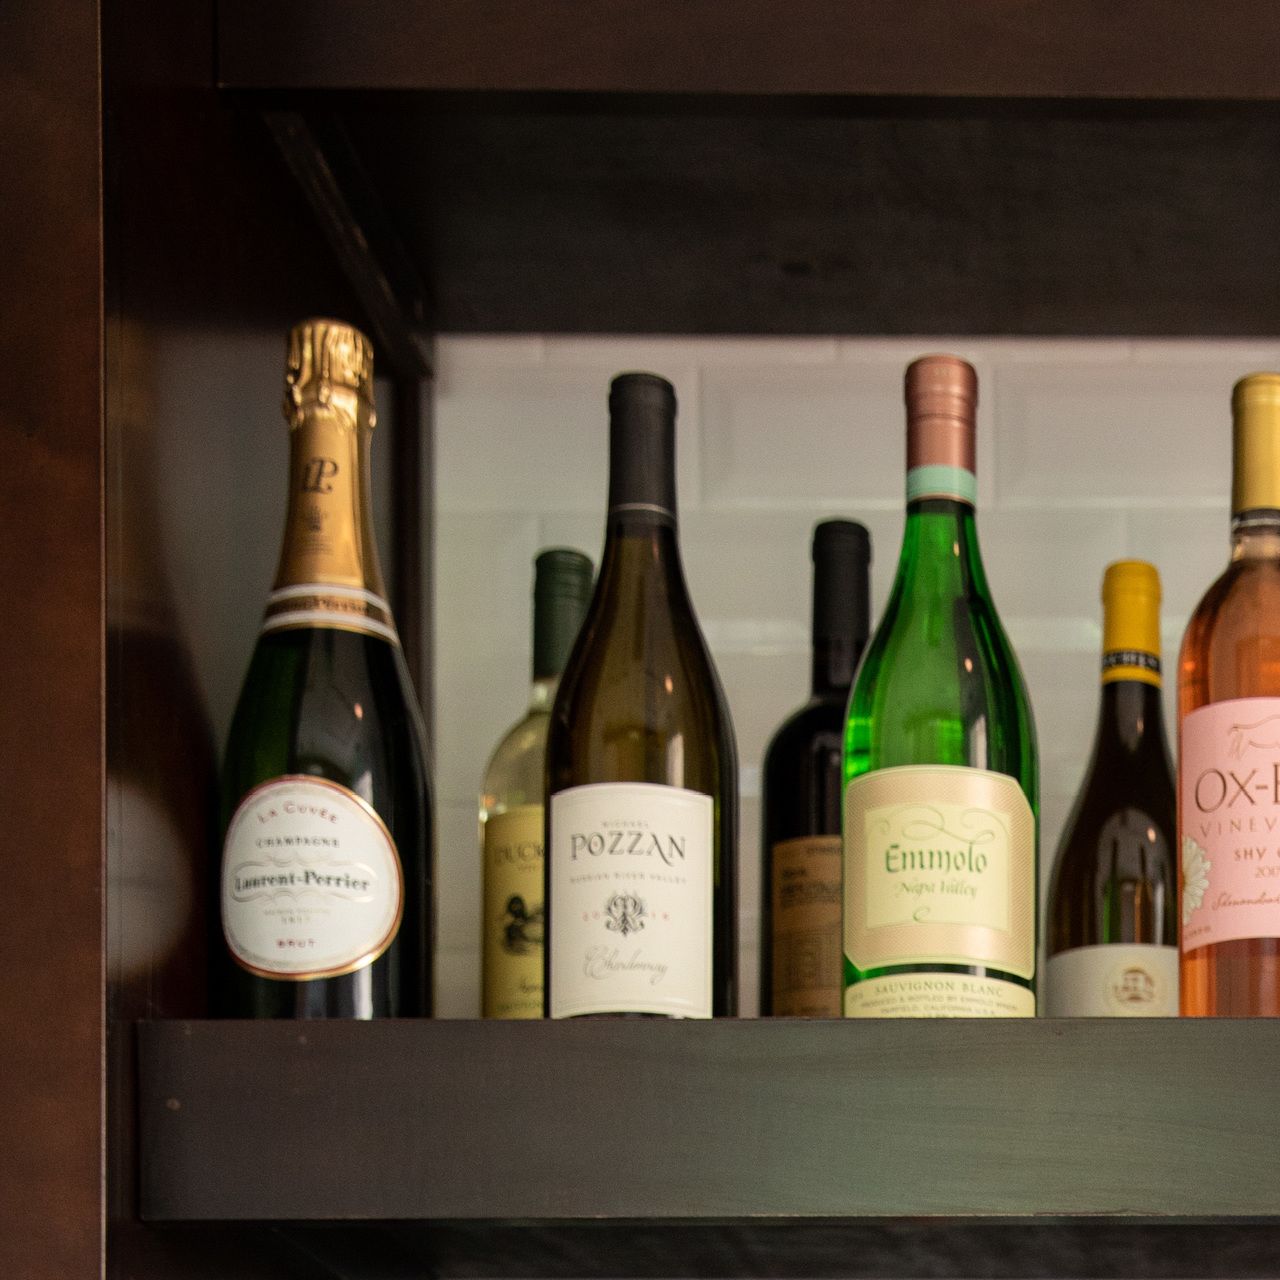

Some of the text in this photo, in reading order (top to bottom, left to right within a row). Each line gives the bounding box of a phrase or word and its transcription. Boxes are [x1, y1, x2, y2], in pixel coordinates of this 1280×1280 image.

[255, 837, 341, 849] CHAMPAGNE
[570, 830, 687, 868] POZZAN
[884, 842, 988, 875] Emmolo
[1233, 846, 1268, 863] SHY
[235, 868, 371, 893] Laurent-Perrier
[276, 938, 317, 949] BRUT
[874, 980, 1004, 997] SAUVIGNON BLANC
